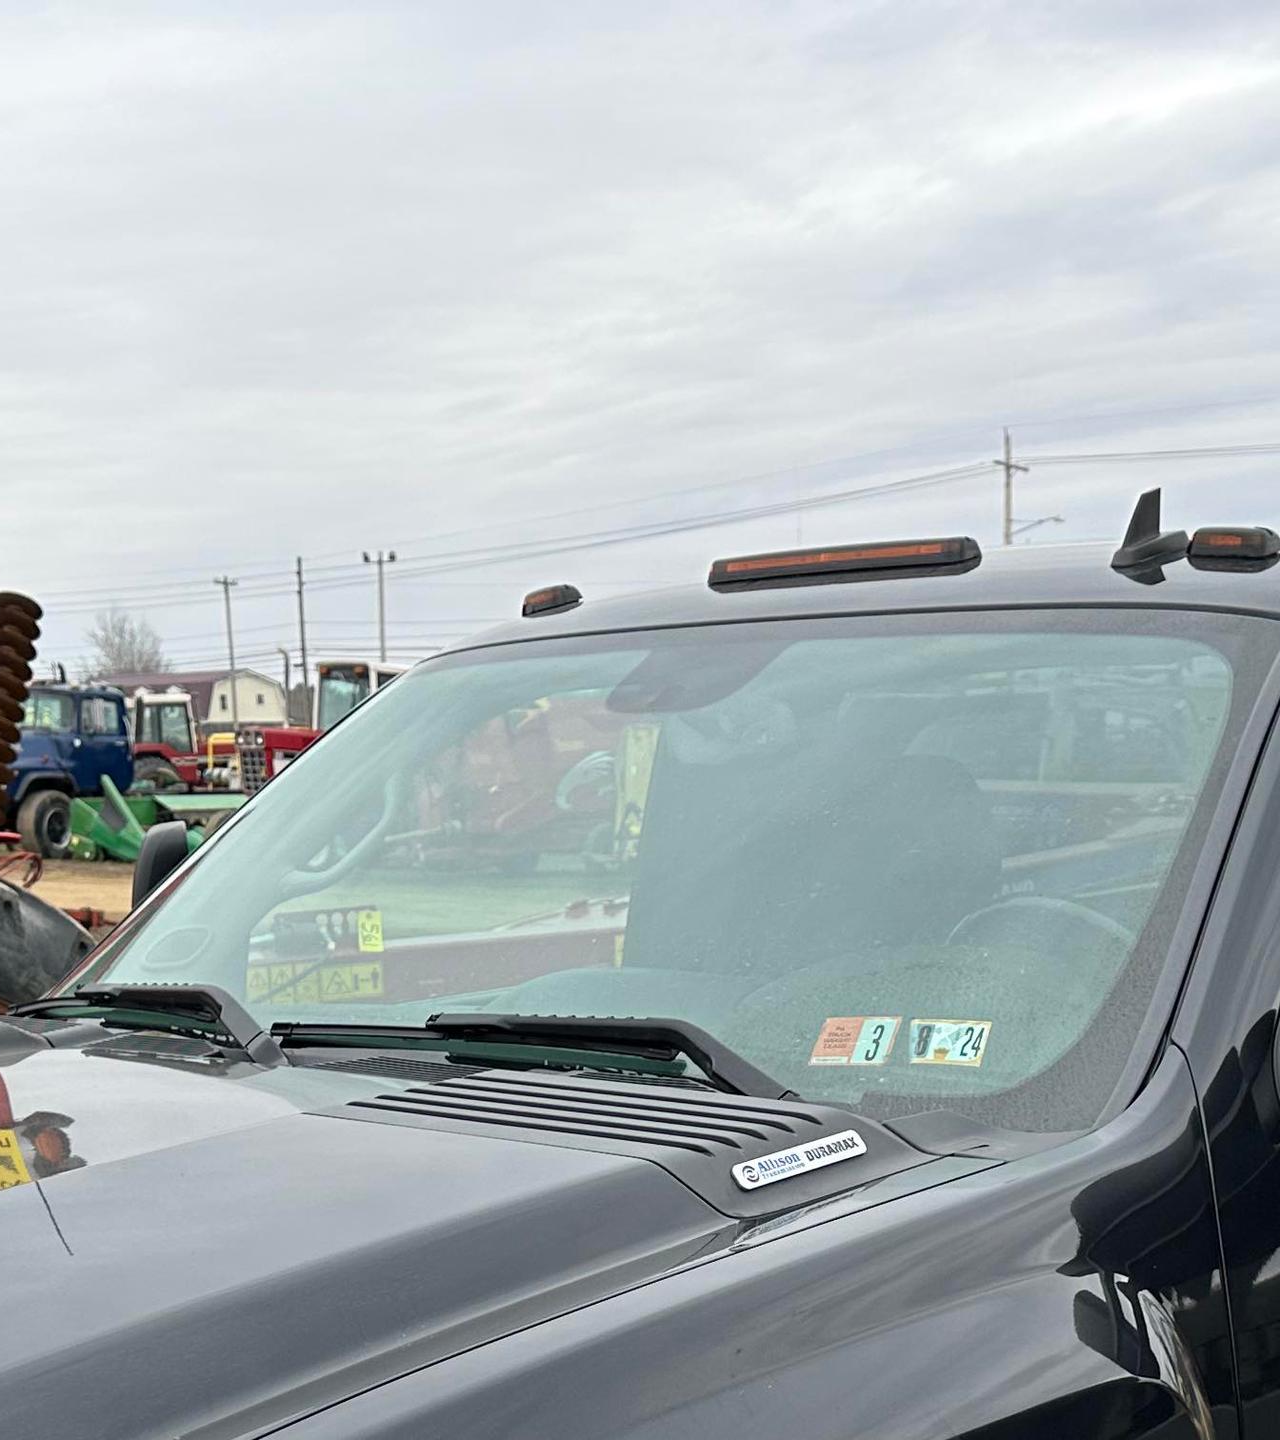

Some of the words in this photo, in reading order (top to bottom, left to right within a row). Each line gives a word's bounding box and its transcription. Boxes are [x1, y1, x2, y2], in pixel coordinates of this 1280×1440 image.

[864, 1024, 885, 1062] 3
[915, 1025, 933, 1057] 8
[959, 1026, 985, 1058] 24
[757, 1153, 801, 1174] Allison
[804, 1136, 859, 1162] DURAMAX
